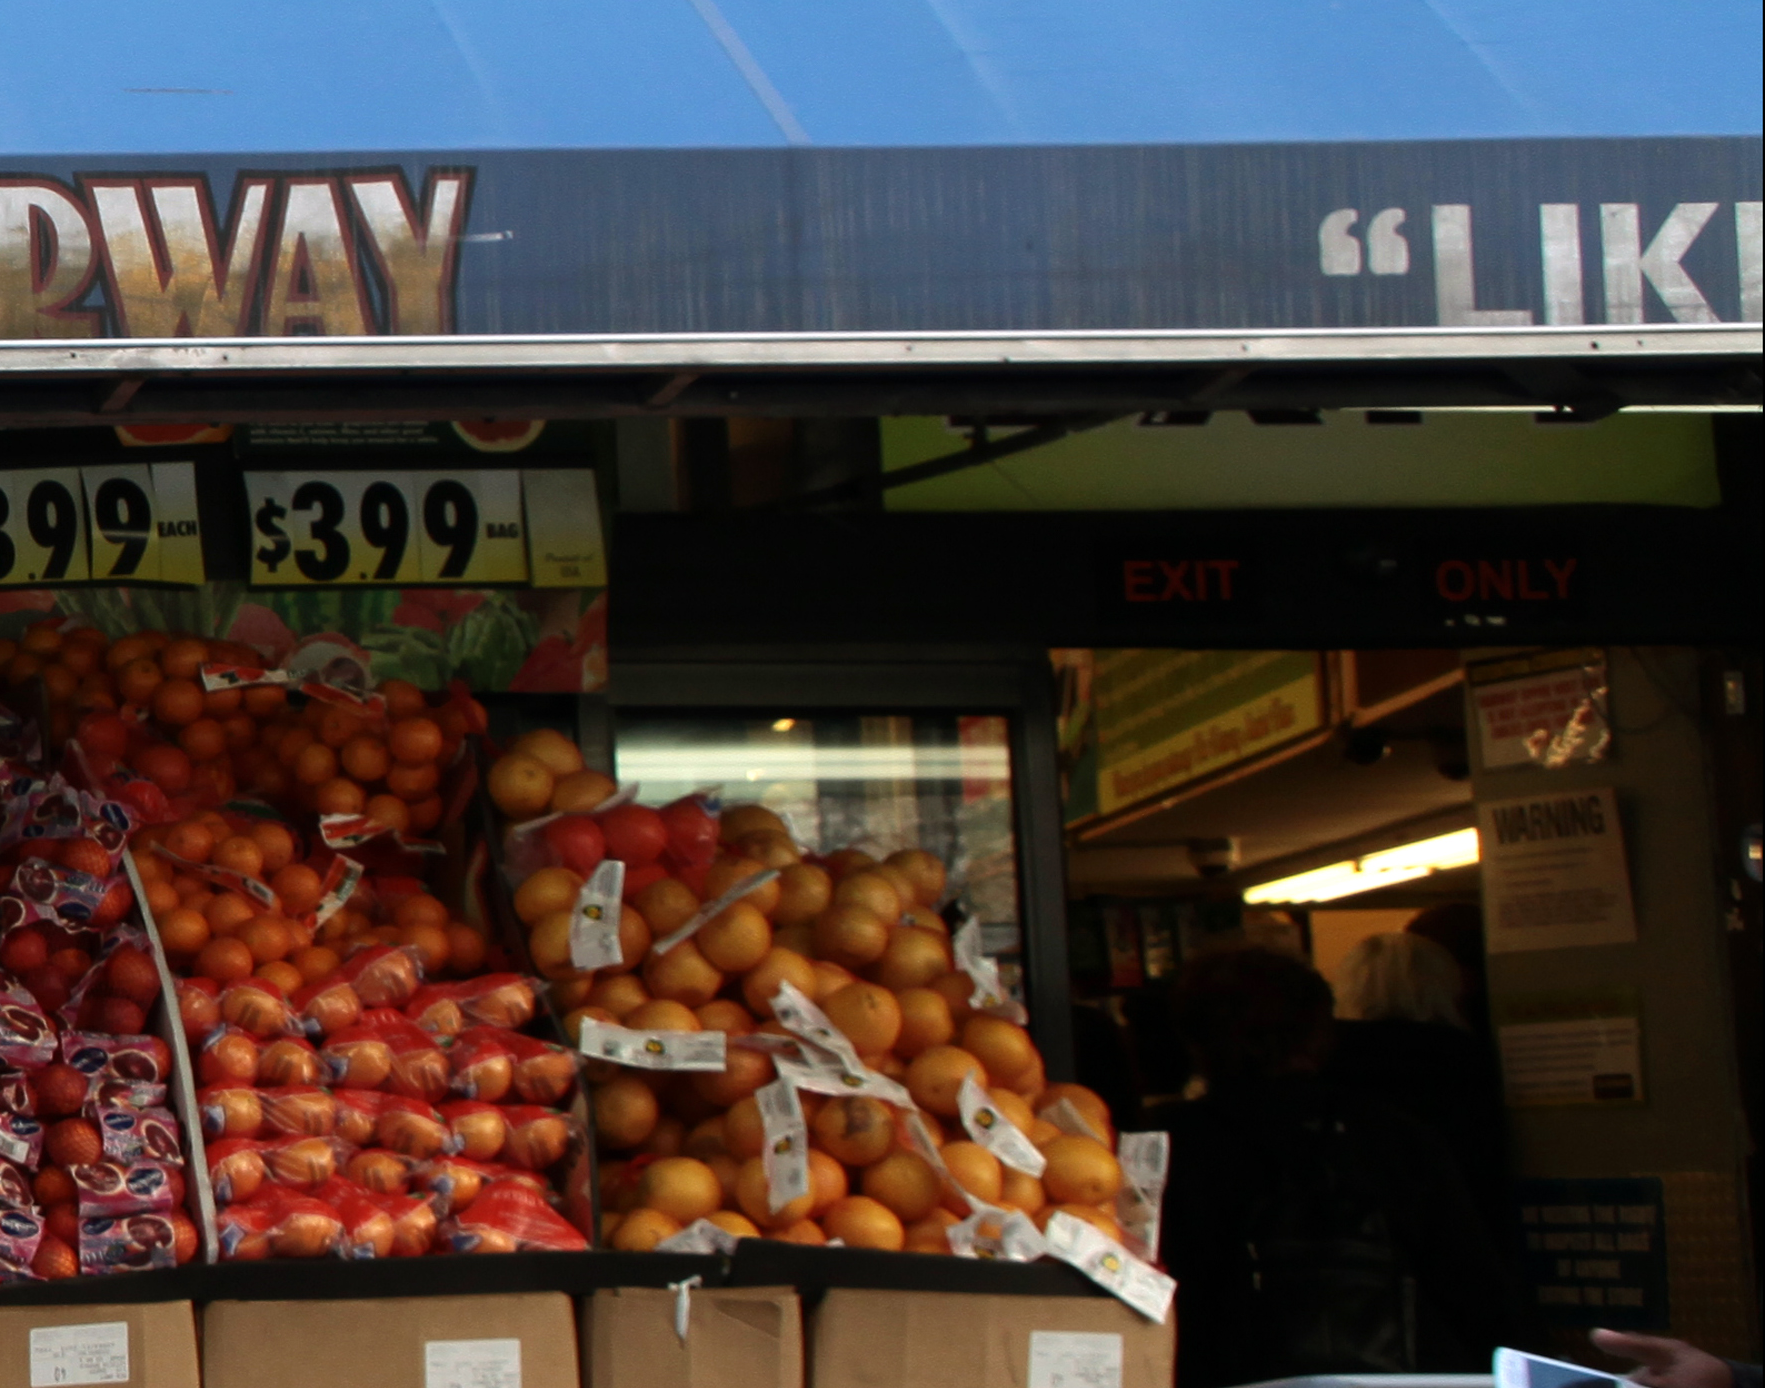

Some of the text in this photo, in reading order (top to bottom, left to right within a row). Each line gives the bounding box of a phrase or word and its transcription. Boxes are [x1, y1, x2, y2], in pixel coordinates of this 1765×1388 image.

[157, 518, 198, 540] EACH
[255, 479, 519, 582] $3.99 BAG
[1122, 556, 1578, 603] EXIT ONLY
[1492, 796, 1606, 844] WARNING
